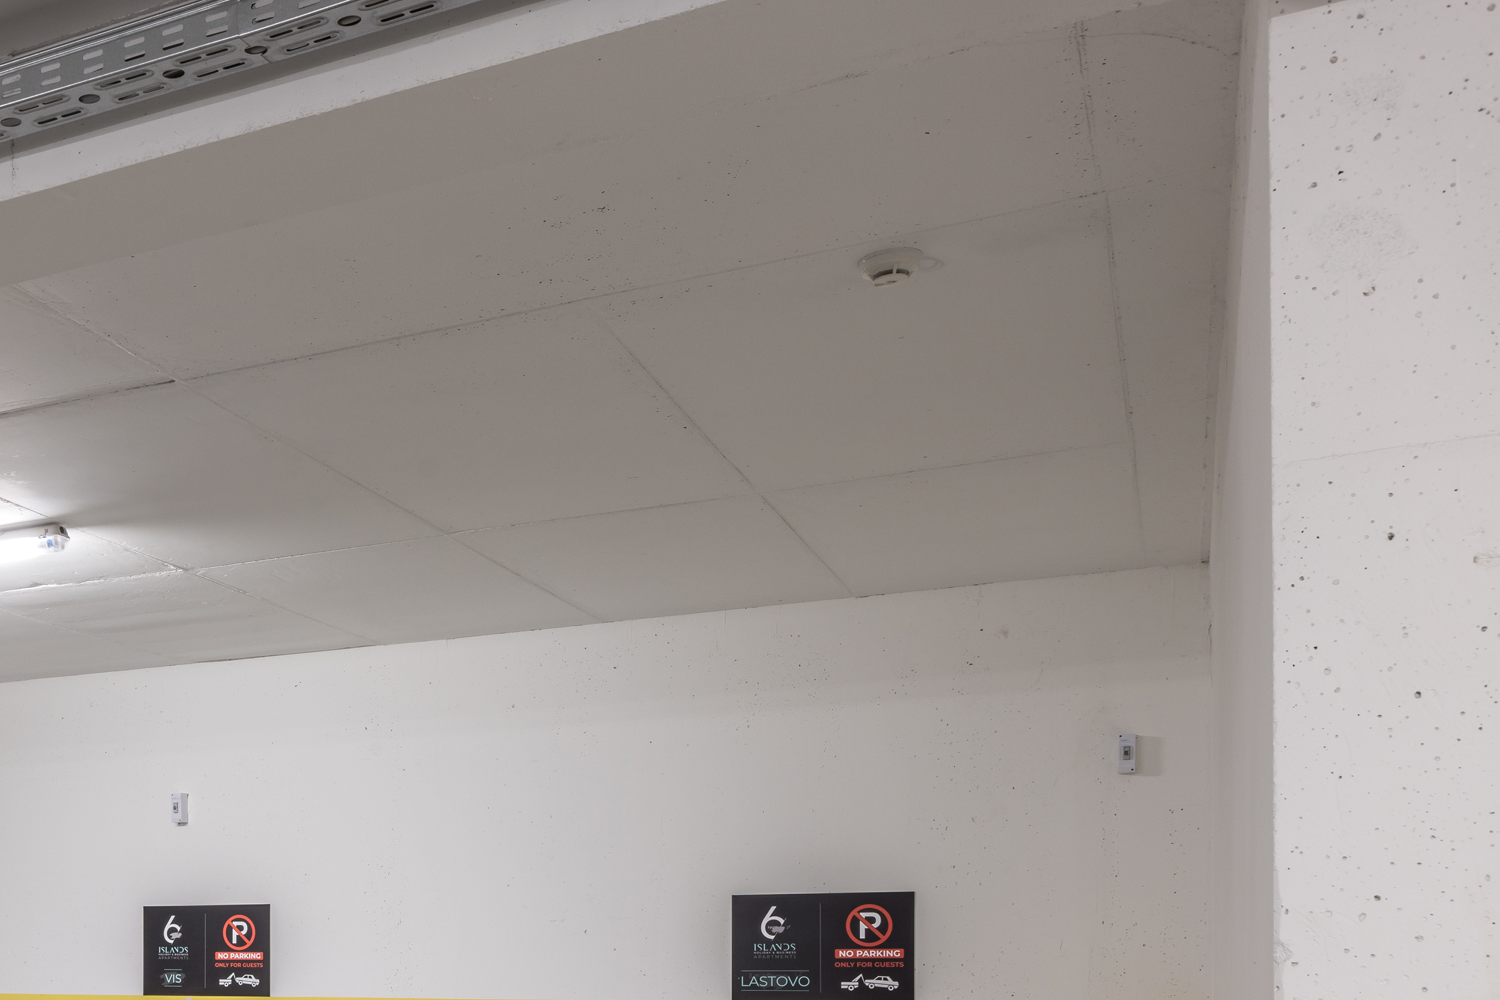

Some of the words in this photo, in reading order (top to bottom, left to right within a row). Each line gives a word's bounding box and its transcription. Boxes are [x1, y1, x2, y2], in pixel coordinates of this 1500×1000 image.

[753, 943, 796, 951] ISLANDS
[164, 973, 182, 984] VIS
[741, 975, 810, 987] LASTOVO
